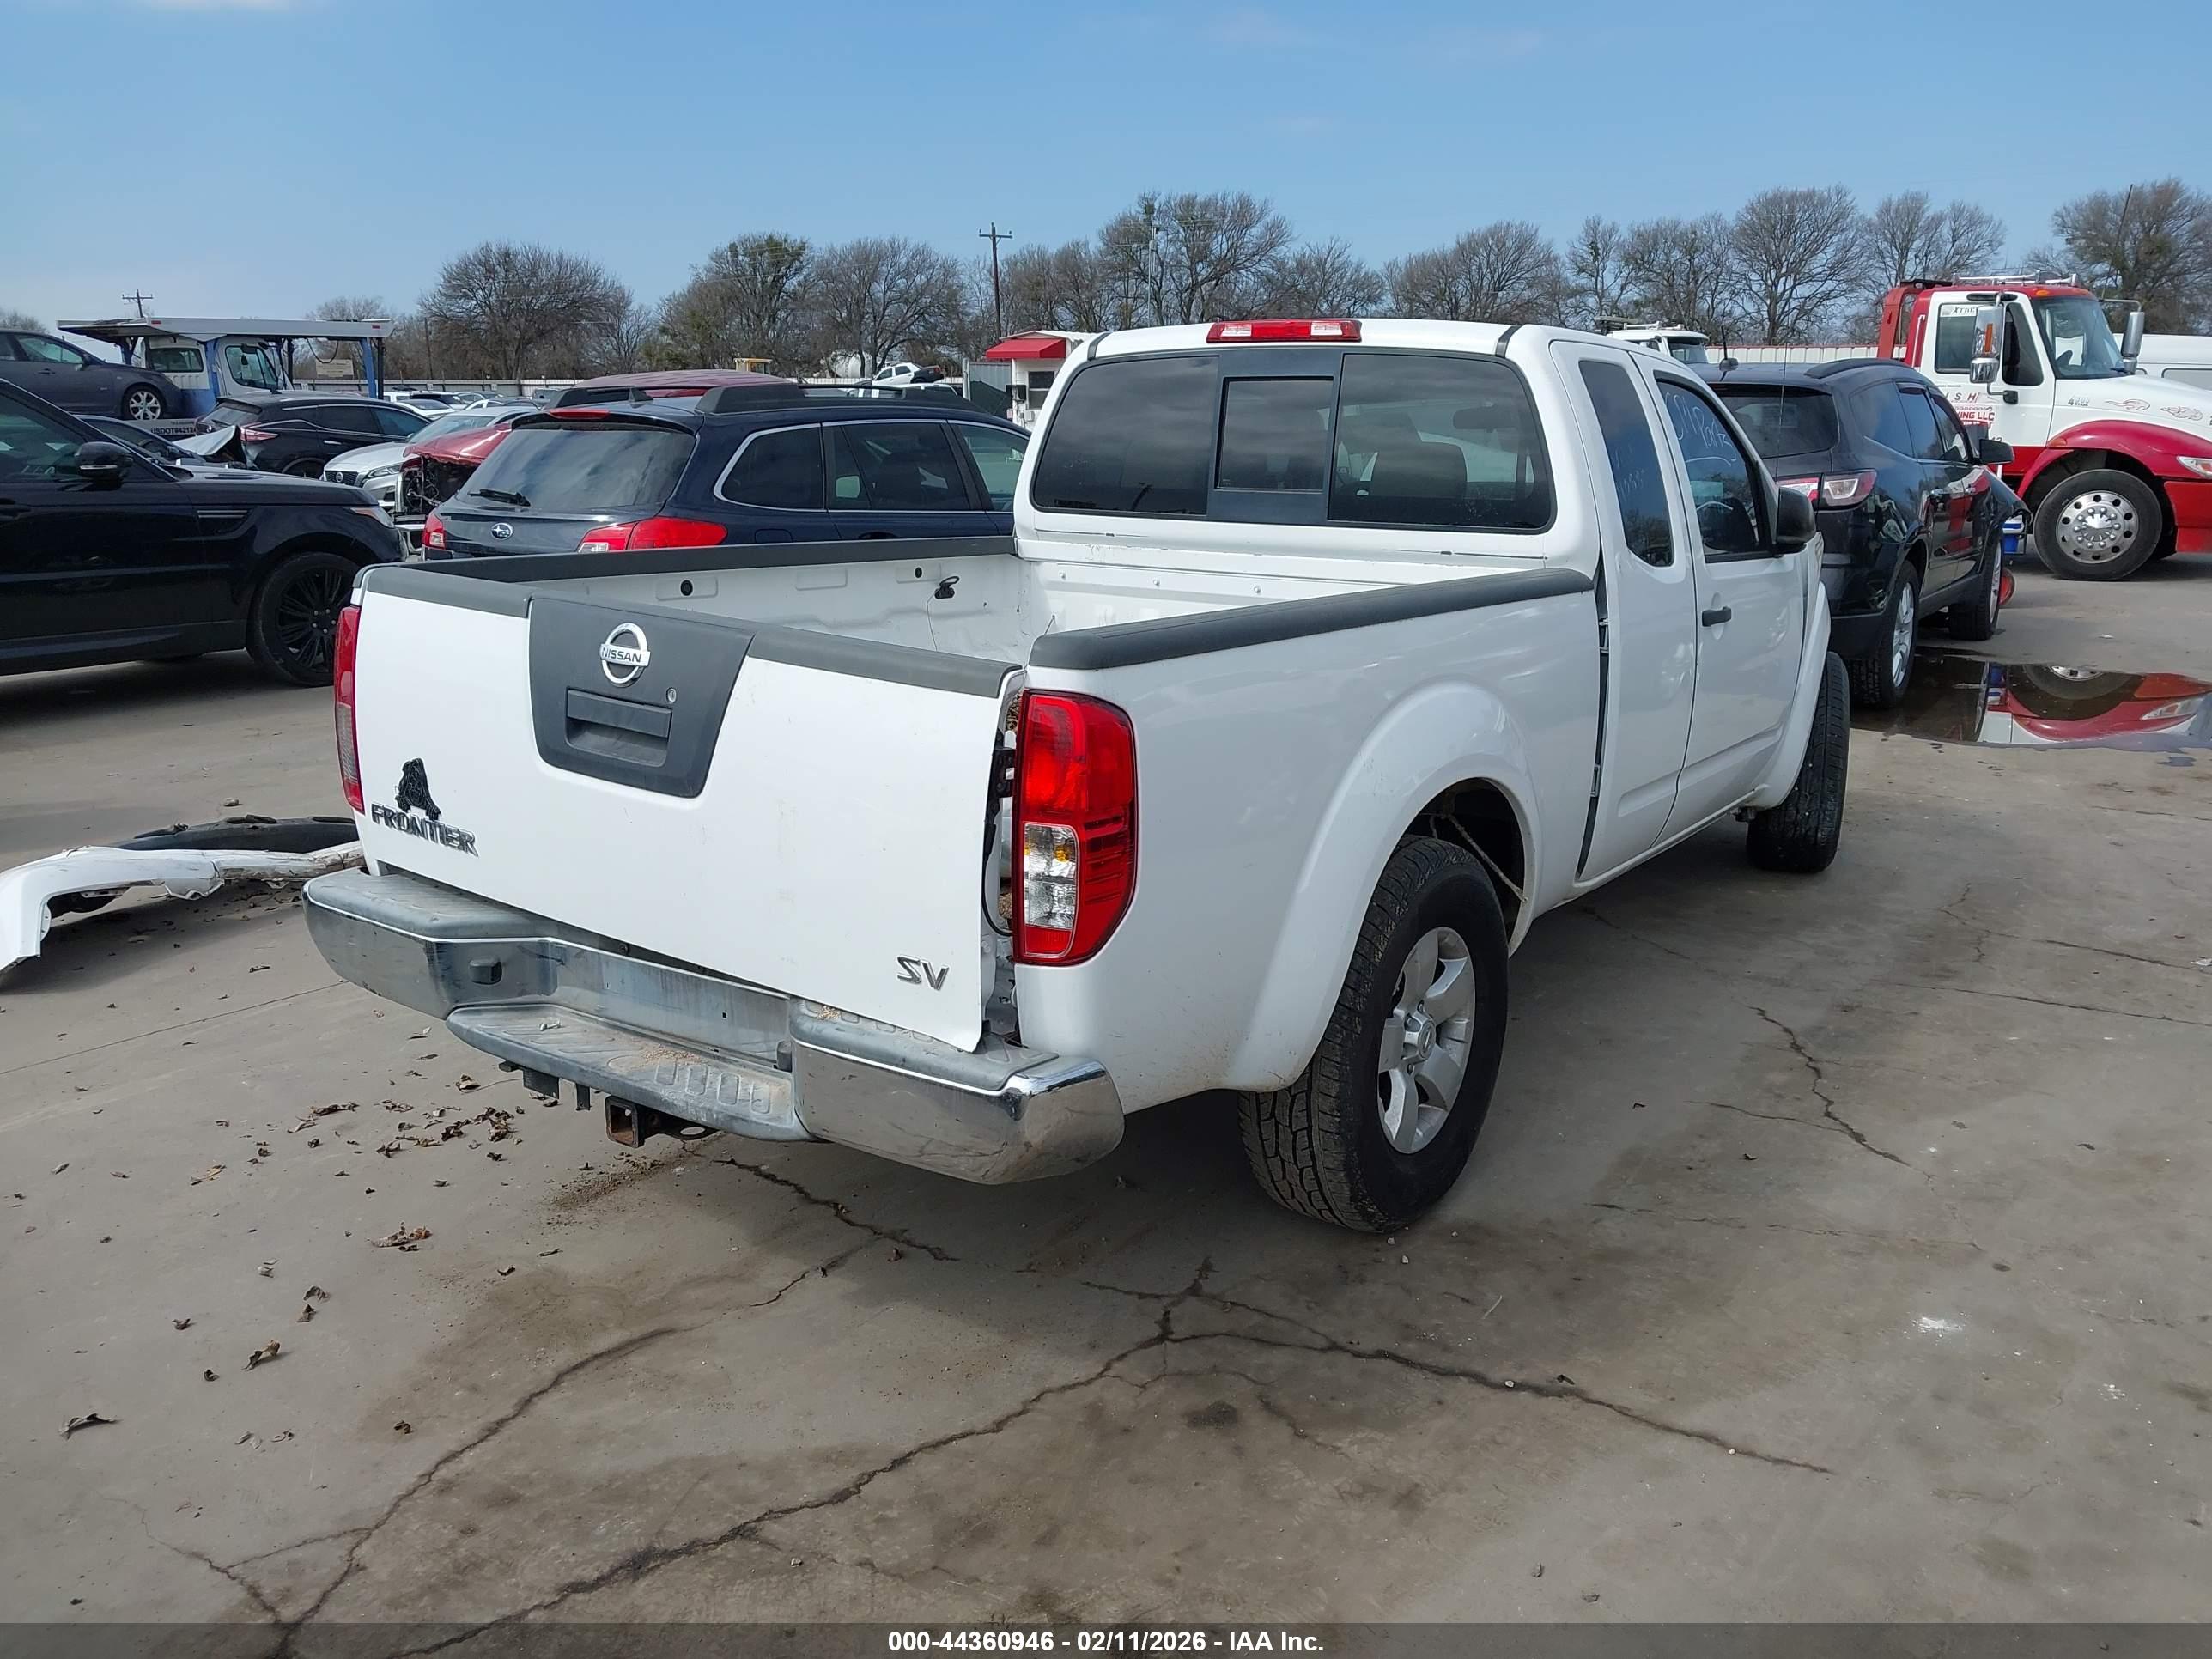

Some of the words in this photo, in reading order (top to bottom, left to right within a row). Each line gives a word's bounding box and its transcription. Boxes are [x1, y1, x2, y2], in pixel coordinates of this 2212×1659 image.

[1977, 412, 1995, 421] LLC
[601, 647, 642, 663] NISSAN
[371, 803, 479, 857] FRONTIER
[896, 955, 949, 991] SV
